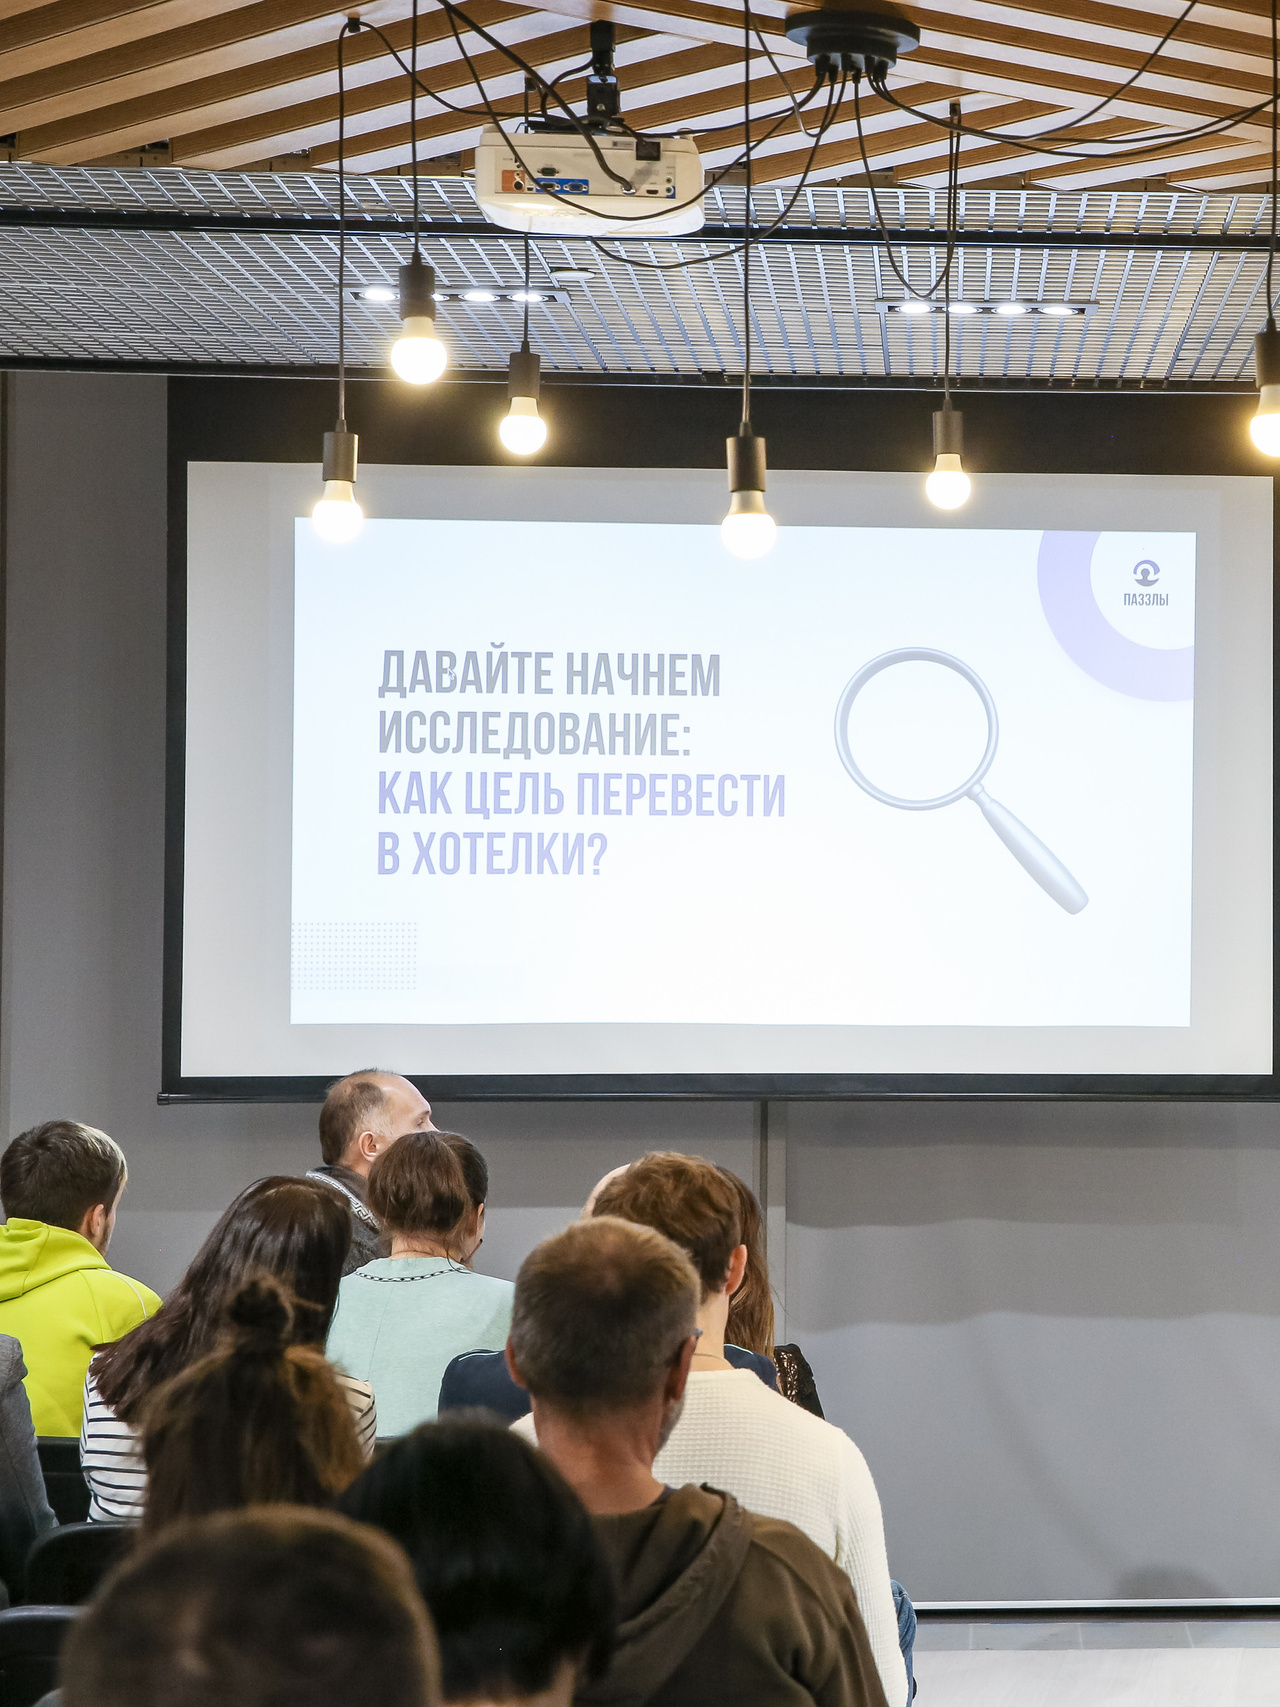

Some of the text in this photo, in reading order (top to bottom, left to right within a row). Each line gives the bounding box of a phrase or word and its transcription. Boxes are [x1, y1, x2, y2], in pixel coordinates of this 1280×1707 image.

[1123, 592, 1169, 607] ПАЗЗЛЫ
[378, 642, 721, 699] ДАВАЙТЕ НАЧНЕМ
[378, 709, 691, 760] ИССЛЕДОВАНИЕ:
[378, 770, 786, 821] КАК ЦЕЛЬ ПЕРЕВЕСТИ
[377, 831, 608, 876] В ХОТЕЛКИ?
